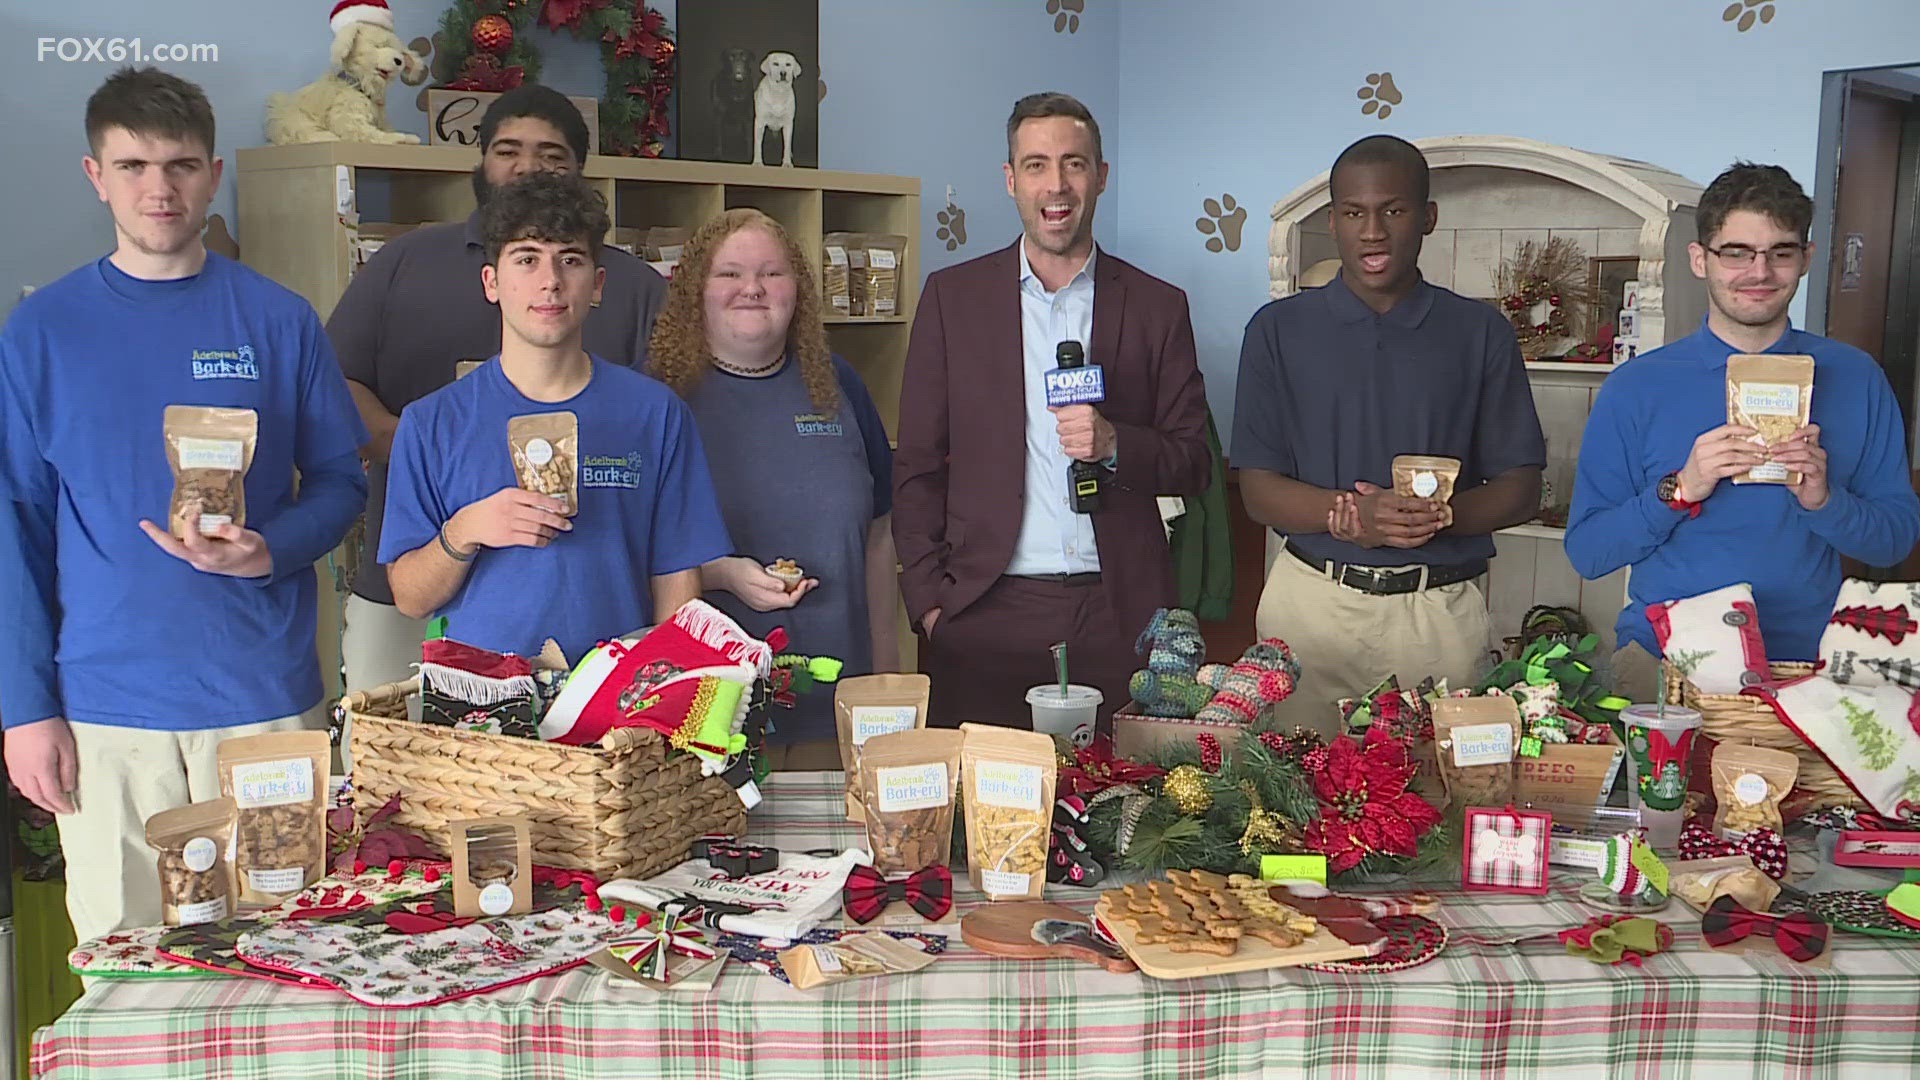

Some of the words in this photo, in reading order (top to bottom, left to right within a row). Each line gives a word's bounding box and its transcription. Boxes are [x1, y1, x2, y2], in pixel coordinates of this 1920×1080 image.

[192, 359, 259, 380] Bark-ery
[1745, 395, 1794, 410] Bark-ery
[583, 467, 640, 489] Bark-ery
[1460, 741, 1509, 755] Bark-ery
[1511, 761, 1576, 784] TREES
[885, 784, 943, 800] Bark-ery
[981, 778, 1034, 801] Bark-ery
[692, 878, 720, 889] YOU
